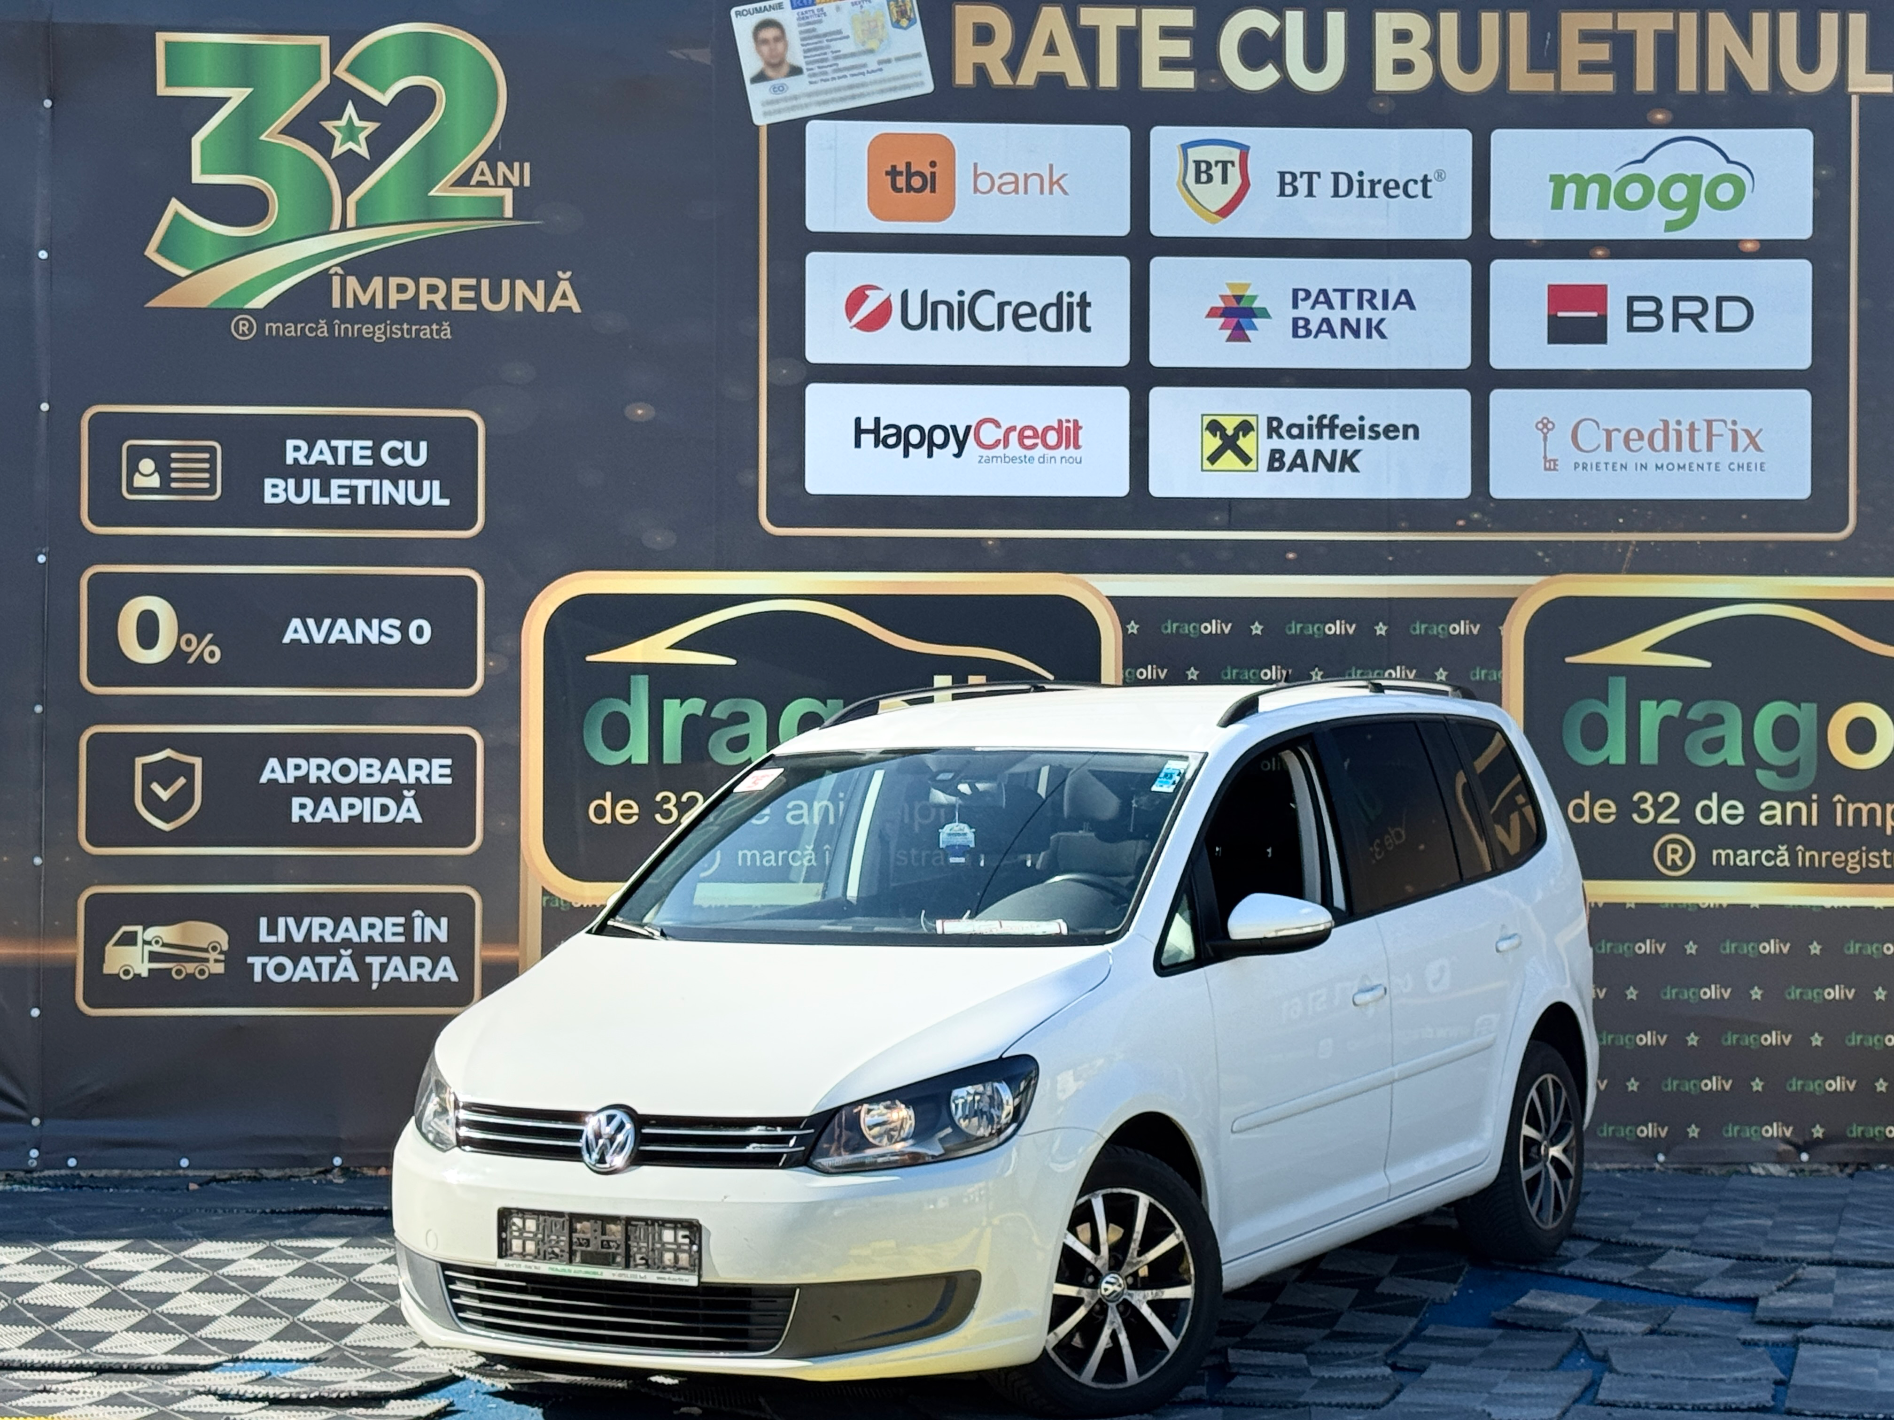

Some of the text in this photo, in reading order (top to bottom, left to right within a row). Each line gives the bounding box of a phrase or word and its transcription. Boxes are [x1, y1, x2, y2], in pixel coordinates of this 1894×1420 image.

[735, 2, 785, 18] ROUMANIE
[953, 4, 1894, 93] RATE CU BULETINUL
[144, 22, 514, 277] 32
[470, 162, 531, 187] ANI
[885, 160, 1070, 196] tbi bank
[1192, 159, 1236, 185] BT
[1276, 171, 1321, 198] BT
[1548, 171, 1747, 233] mogo
[328, 266, 583, 313] ÎMPREUNĂ
[1291, 287, 1417, 311] PATRIA
[900, 288, 1092, 334] UniCredit
[1626, 295, 1755, 333] BRD
[264, 319, 329, 338] marcă
[333, 319, 452, 343] înregistrată
[1291, 316, 1388, 339] BANK
[854, 416, 1083, 459] HappyCredit
[1266, 414, 1420, 441] Raiffeisen
[1570, 418, 1765, 454] CreditFix
[285, 438, 429, 467] RATE CU
[977, 453, 1083, 465] zambeste din nou
[1266, 448, 1363, 473] BANK
[1573, 461, 1766, 472] PRIETEN IN MOMENTE CHEIE
[263, 478, 451, 506] BULETINUL
[281, 617, 433, 646] AVANS 0
[1160, 618, 1233, 638] dragoliv
[1285, 619, 1356, 639] dragoliv
[1409, 620, 1481, 639] dragoliv
[259, 757, 453, 785] APROBARE
[291, 789, 423, 823] RAPIDĂ
[588, 791, 640, 825] de
[1568, 791, 1617, 825] de
[1631, 791, 1681, 825] 32
[1695, 792, 1745, 826] de
[1759, 793, 1818, 827] ani
[1711, 845, 1791, 868] marcă
[258, 909, 448, 944] LIVRARE ÎN
[1595, 939, 1667, 958] dragoliv
[1720, 939, 1791, 958] dragoliv
[247, 948, 460, 990] TOATĂ ȚARA
[1660, 984, 1732, 1004] dragoliv
[1785, 984, 1856, 1004] dragoliv
[1721, 1030, 1792, 1050] dragoliv
[1661, 1075, 1733, 1095] dragoliv
[1785, 1076, 1857, 1096] dragoliv
[1597, 1122, 1669, 1141] dragoliv
[1722, 1122, 1793, 1141] dragoliv
